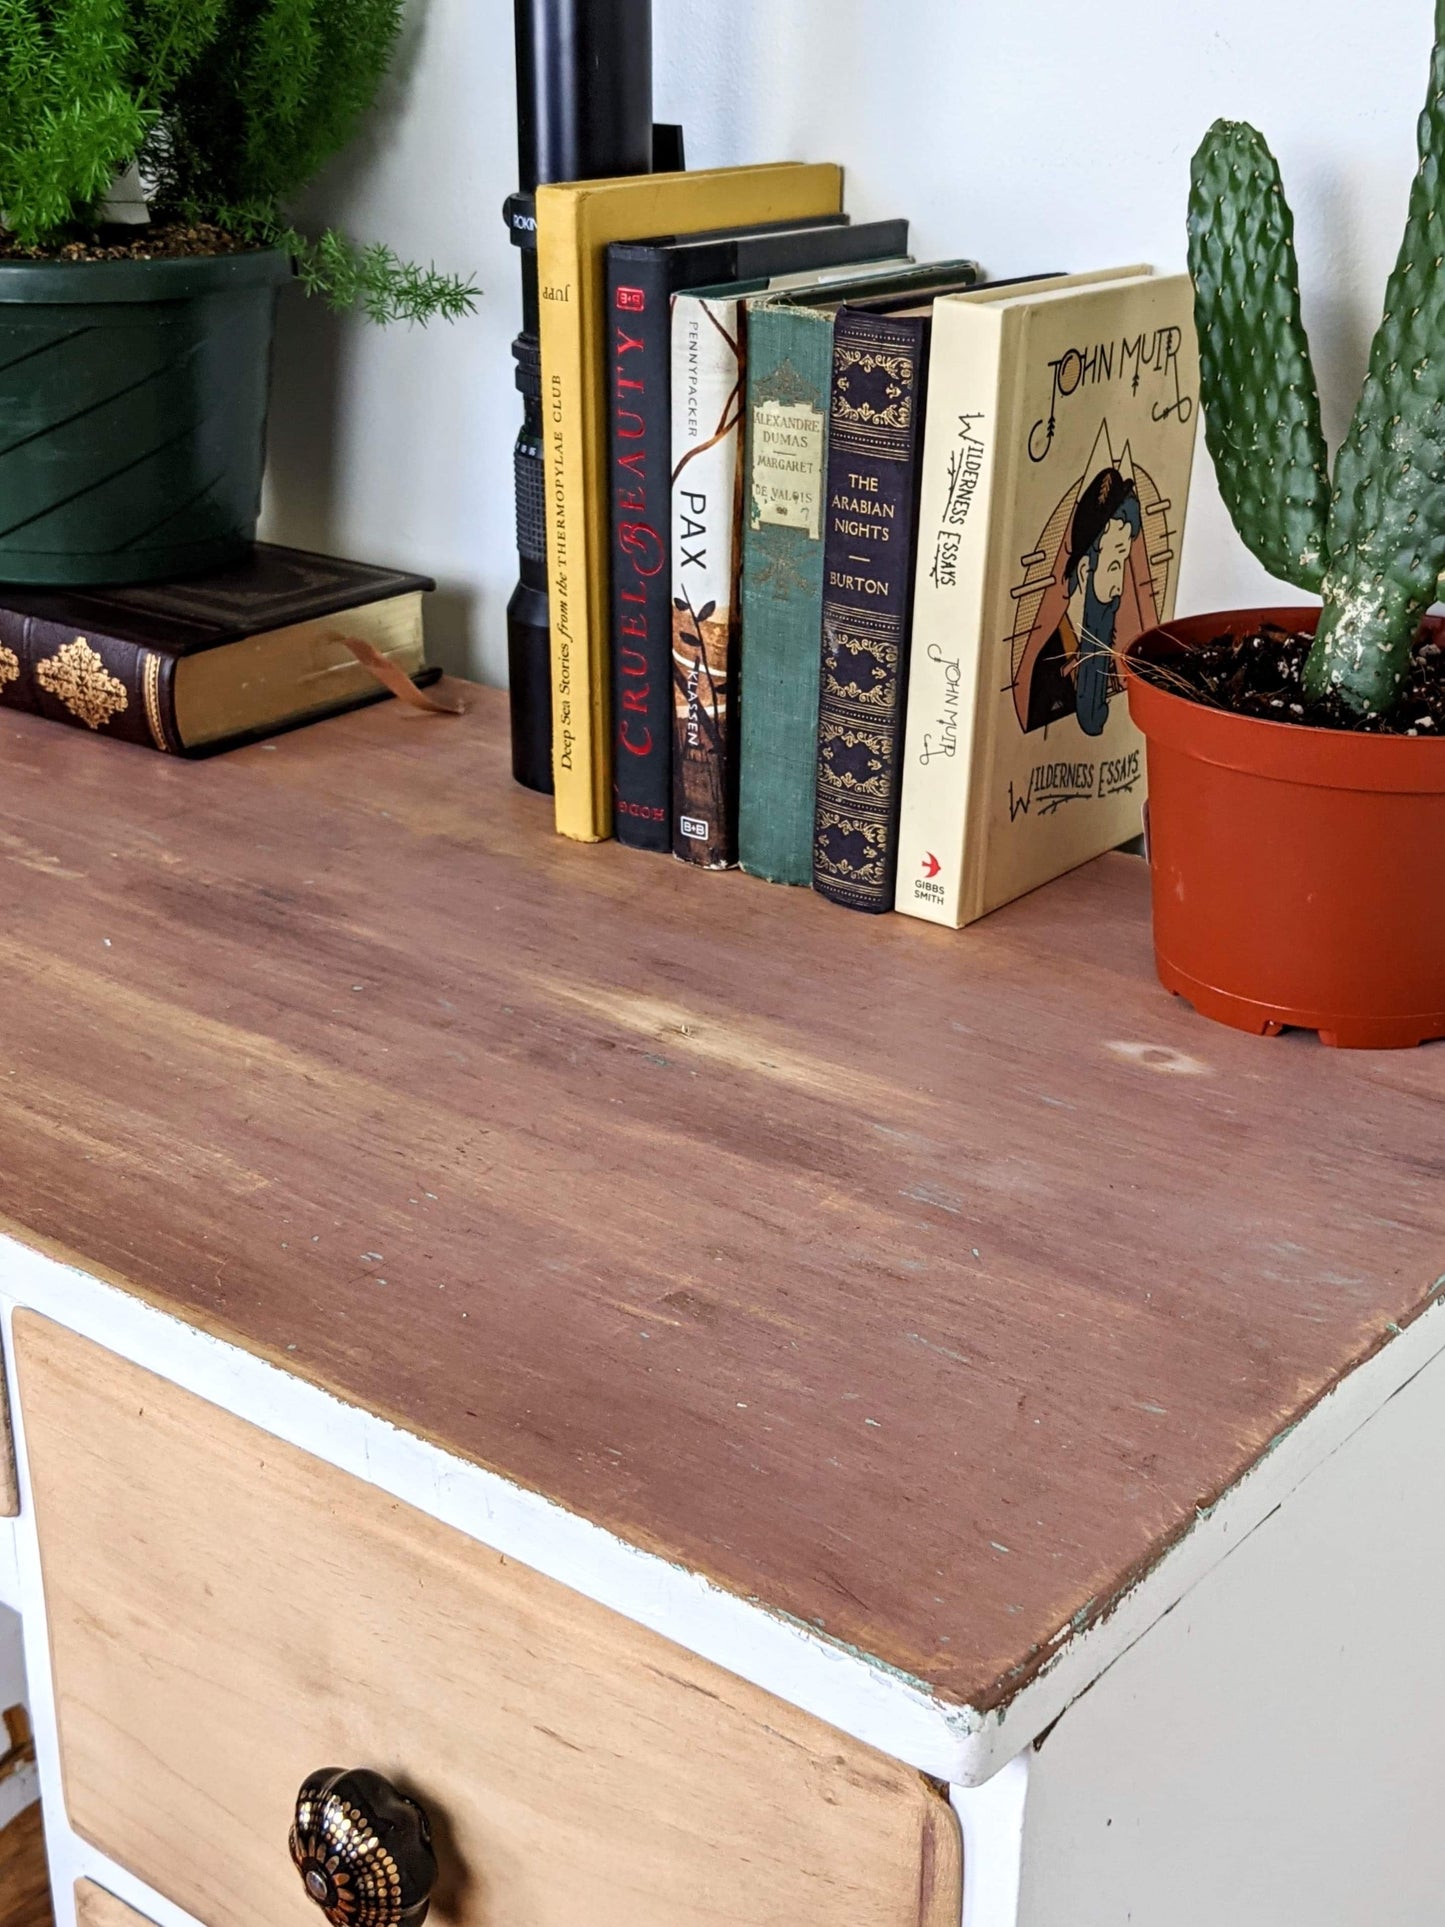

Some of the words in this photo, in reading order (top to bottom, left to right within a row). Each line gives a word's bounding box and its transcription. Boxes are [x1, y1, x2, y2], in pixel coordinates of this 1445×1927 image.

[542, 284, 570, 302] JUPP
[551, 375, 562, 423] CLUB
[688, 321, 699, 437] PENNYPACKER
[1028, 341, 1114, 462] JOHN
[1119, 326, 1192, 423] MUIR
[754, 413, 820, 433] ALEXANDRE
[763, 431, 808, 448] DUMAS
[616, 327, 665, 577] BEAUTY
[757, 456, 813, 474] MARGARET
[949, 412, 985, 525] WILDERNESS
[553, 431, 567, 567] THERMOPYLAE
[755, 484, 768, 497] DE
[771, 487, 813, 504] VALOIS
[848, 474, 879, 492] THE
[831, 495, 895, 519] ARABIAN
[680, 490, 707, 570] PAX
[834, 518, 889, 542] NIGHTS
[937, 530, 961, 587] ESSAYS
[556, 571, 568, 597] the
[829, 571, 889, 596] BURTON
[557, 601, 573, 643] from
[558, 643, 571, 696] Stories
[619, 580, 653, 756] CRUEL
[927, 643, 961, 705] JOHN
[560, 699, 571, 726] Sea
[687, 670, 699, 746] KLASSEN
[561, 730, 576, 771] Deep
[919, 709, 958, 766] MUIR
[1008, 763, 1094, 823] WILDERNESS
[1098, 749, 1139, 798] ESSAYS
[914, 879, 945, 895] GIBBS
[914, 890, 945, 906] SMITH
